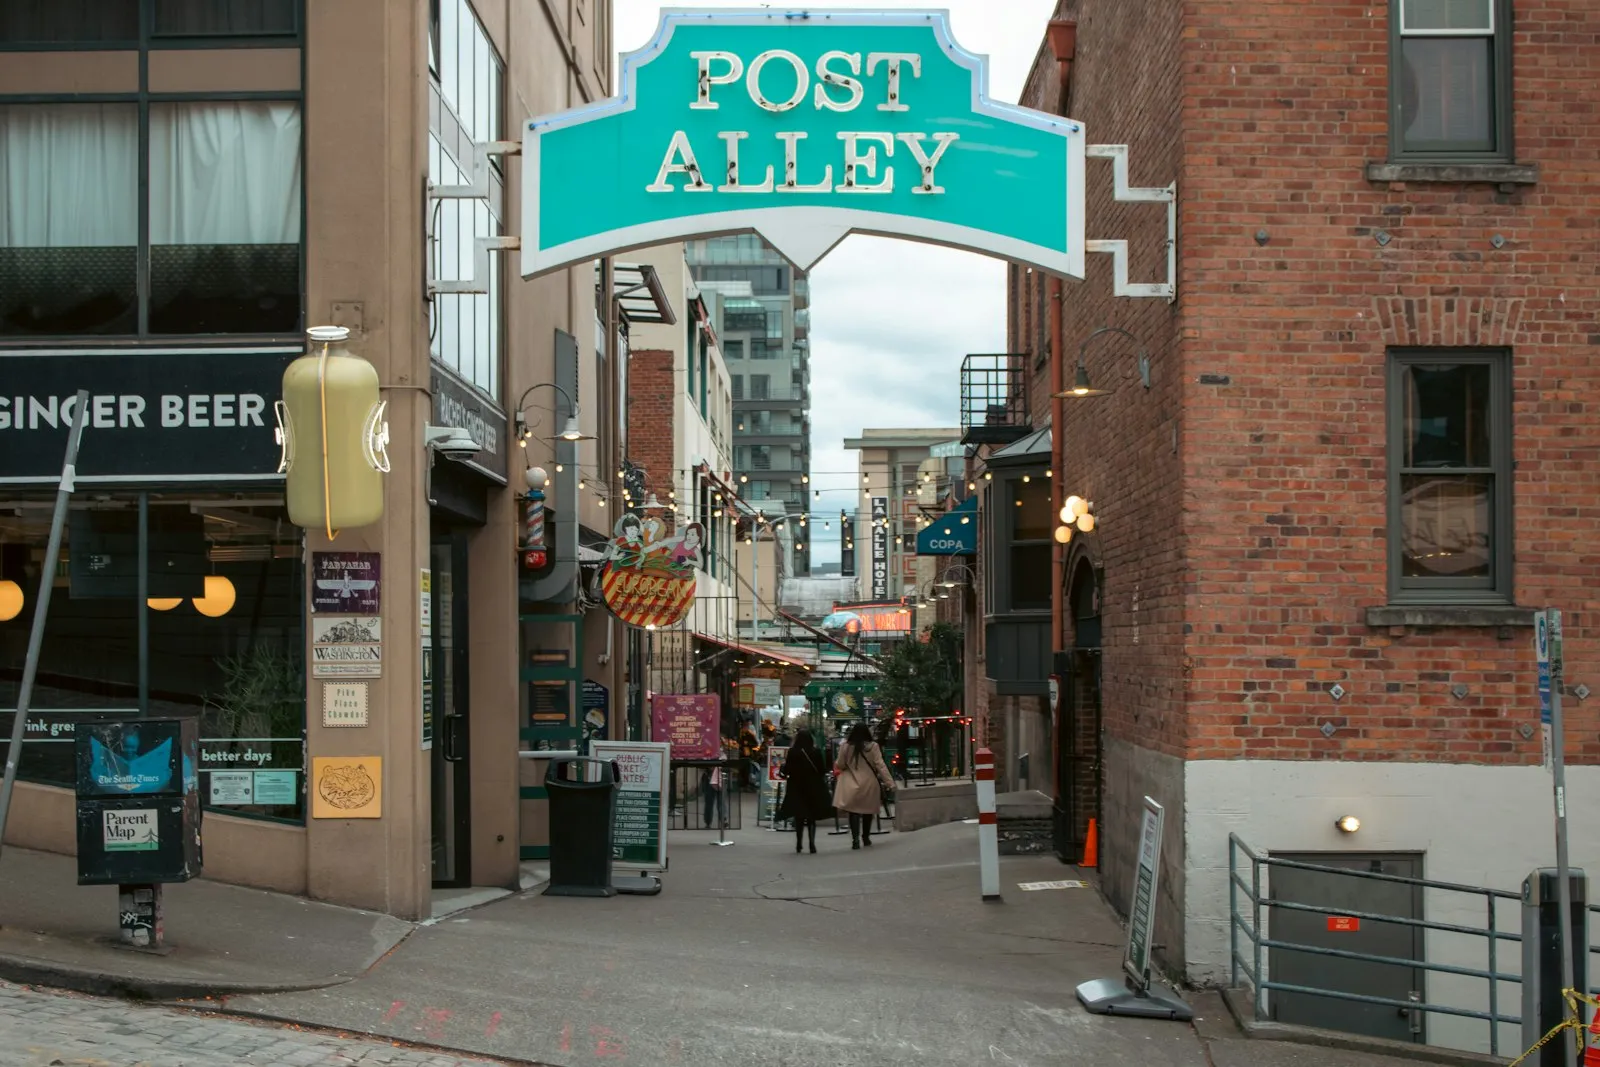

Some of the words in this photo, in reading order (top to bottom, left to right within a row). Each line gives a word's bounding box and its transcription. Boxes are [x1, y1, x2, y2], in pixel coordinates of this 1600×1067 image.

[688, 49, 922, 112] POST
[645, 130, 960, 194] ALLEY
[161, 393, 266, 428] BEER
[873, 498, 886, 514] LA
[873, 517, 887, 559] SALLE
[929, 538, 964, 550] COPA
[313, 646, 380, 660] WASHINGTON
[202, 749, 240, 762] better
[243, 749, 272, 765] days
[616, 755, 646, 764] PUBLIC
[618, 764, 639, 773] RKET
[98, 775, 113, 784] The
[113, 774, 136, 783] Seattle
[137, 774, 160, 783] Times
[623, 774, 645, 783] NTER
[106, 812, 149, 825] Parent
[106, 825, 136, 840] Map
